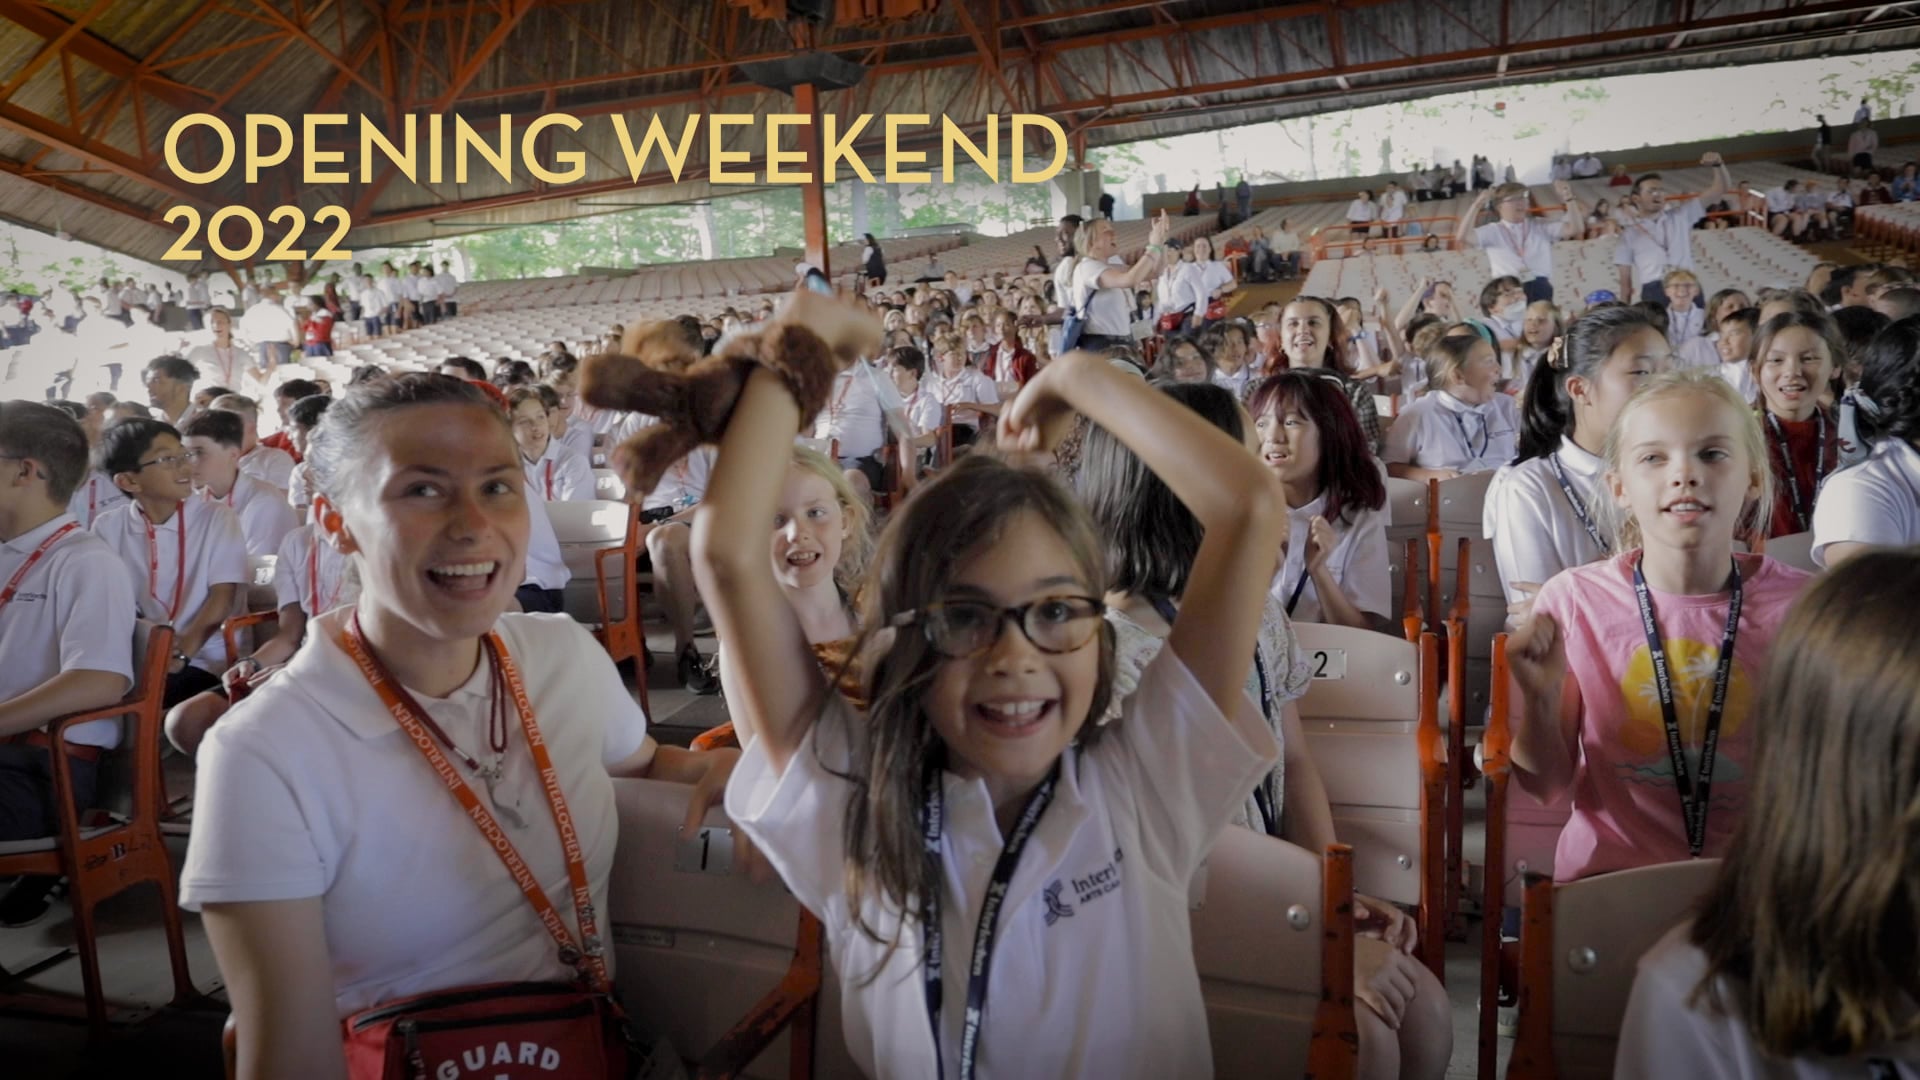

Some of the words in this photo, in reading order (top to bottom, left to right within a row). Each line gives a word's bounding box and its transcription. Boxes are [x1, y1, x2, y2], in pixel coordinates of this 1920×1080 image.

[1638, 591, 1655, 634] Interlochen
[1314, 651, 1328, 677] 2
[1655, 659, 1671, 704] Interlochen
[503, 656, 544, 746] INTERLOCHEN
[391, 702, 462, 789] INTERLOCHEN
[542, 767, 582, 864] INTERLOCHEN
[469, 805, 536, 892] INTERLOCHEN
[701, 829, 710, 870] 1
[437, 1041, 561, 1080] GUARD
